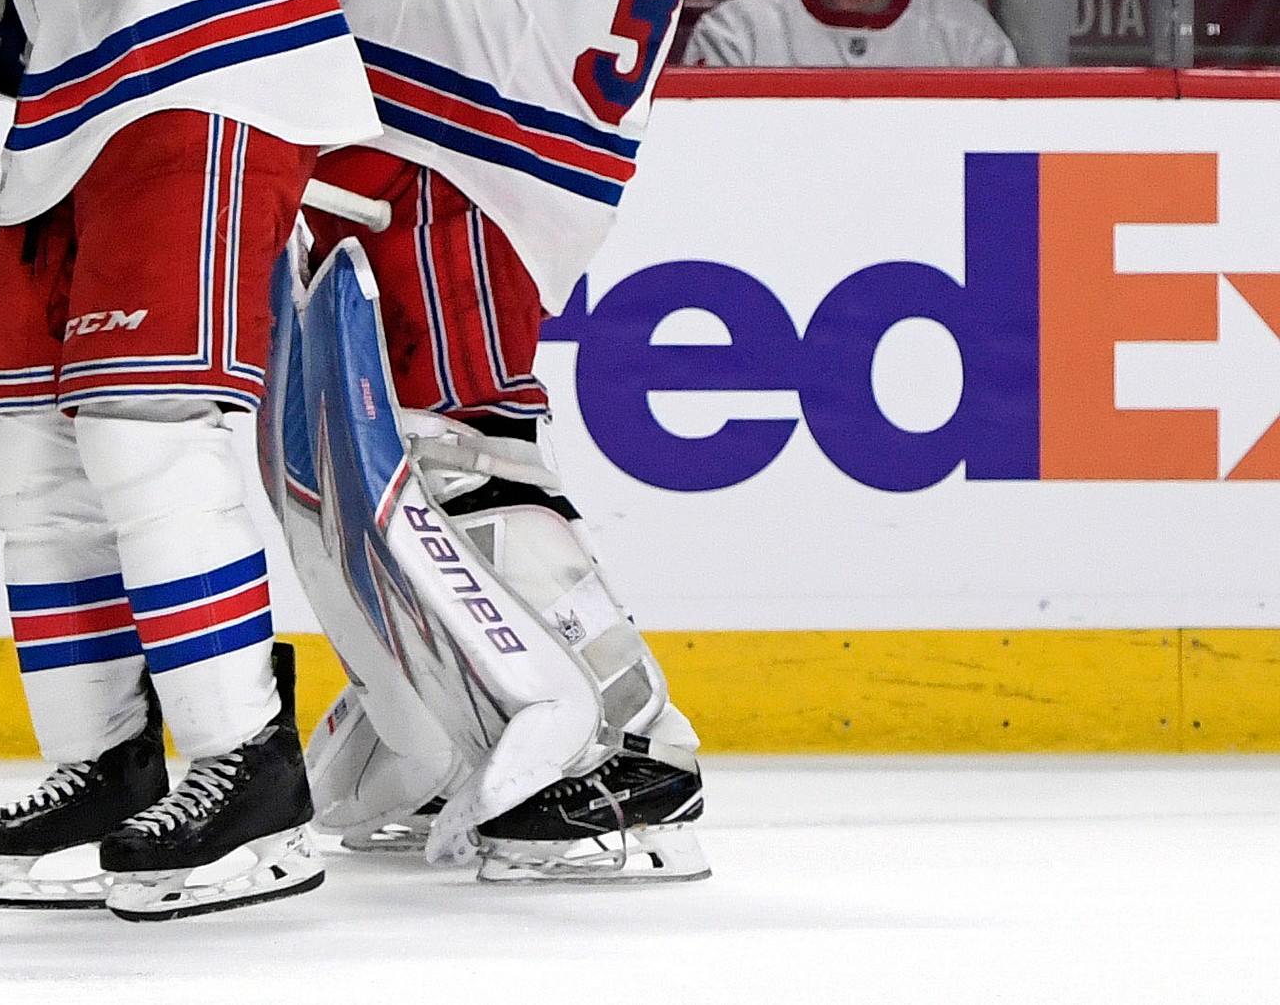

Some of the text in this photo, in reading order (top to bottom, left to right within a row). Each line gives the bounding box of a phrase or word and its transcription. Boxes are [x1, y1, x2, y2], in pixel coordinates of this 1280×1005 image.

[63, 308, 150, 345] CCM
[539, 151, 1280, 493] edE
[403, 505, 528, 655] BAUER
